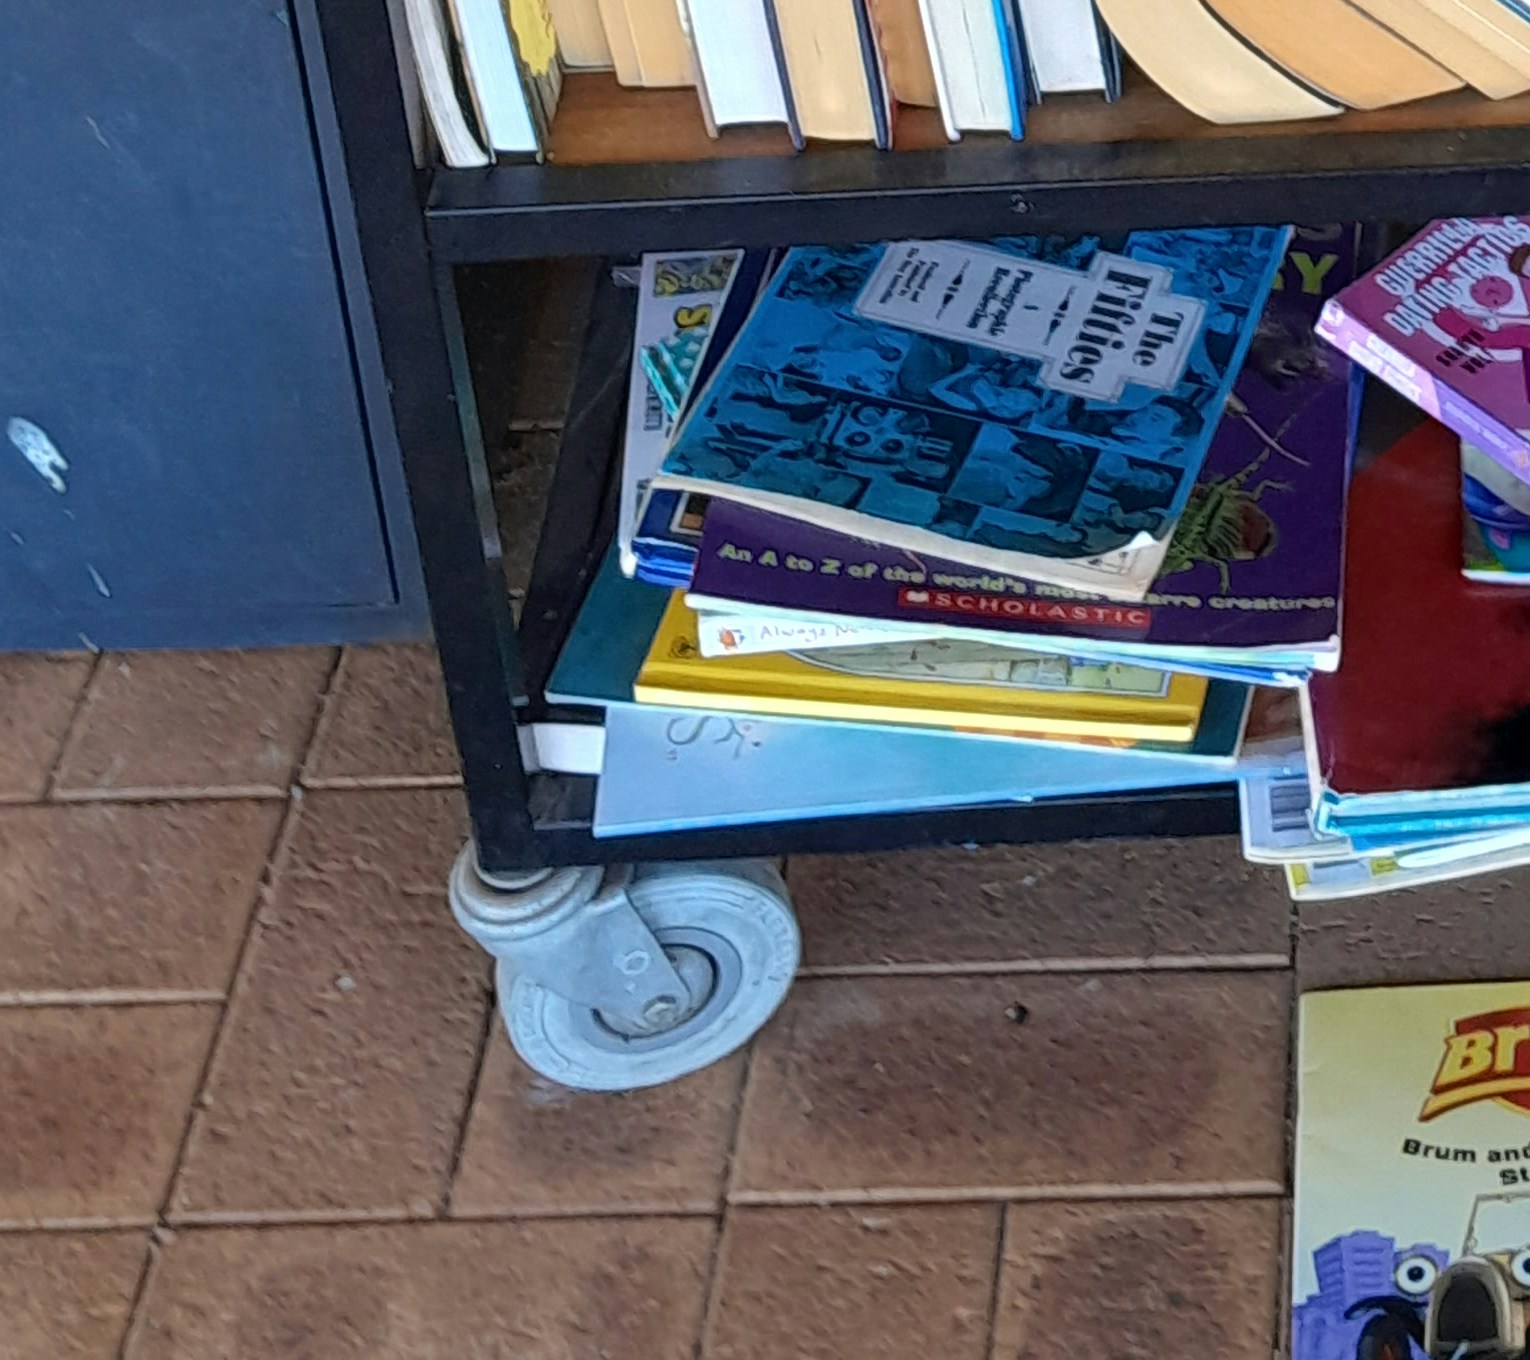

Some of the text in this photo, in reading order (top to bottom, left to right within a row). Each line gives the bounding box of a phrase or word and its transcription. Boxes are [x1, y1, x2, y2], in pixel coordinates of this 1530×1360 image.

[1375, 217, 1481, 297] GUERRILLA
[1060, 267, 1153, 385] Fifties
[1383, 269, 1458, 337] DATING
[1132, 311, 1185, 368] The
[717, 542, 754, 563] An
[757, 546, 783, 568] A
[784, 553, 815, 573] to
[818, 557, 841, 577] Z
[847, 559, 878, 581] of
[882, 562, 926, 586] the
[931, 569, 1028, 598] world's
[1207, 591, 1336, 612] creatures
[757, 620, 832, 644] Always
[936, 592, 1148, 627] SCHOLASTIC
[1400, 1138, 1479, 1164] Brum
